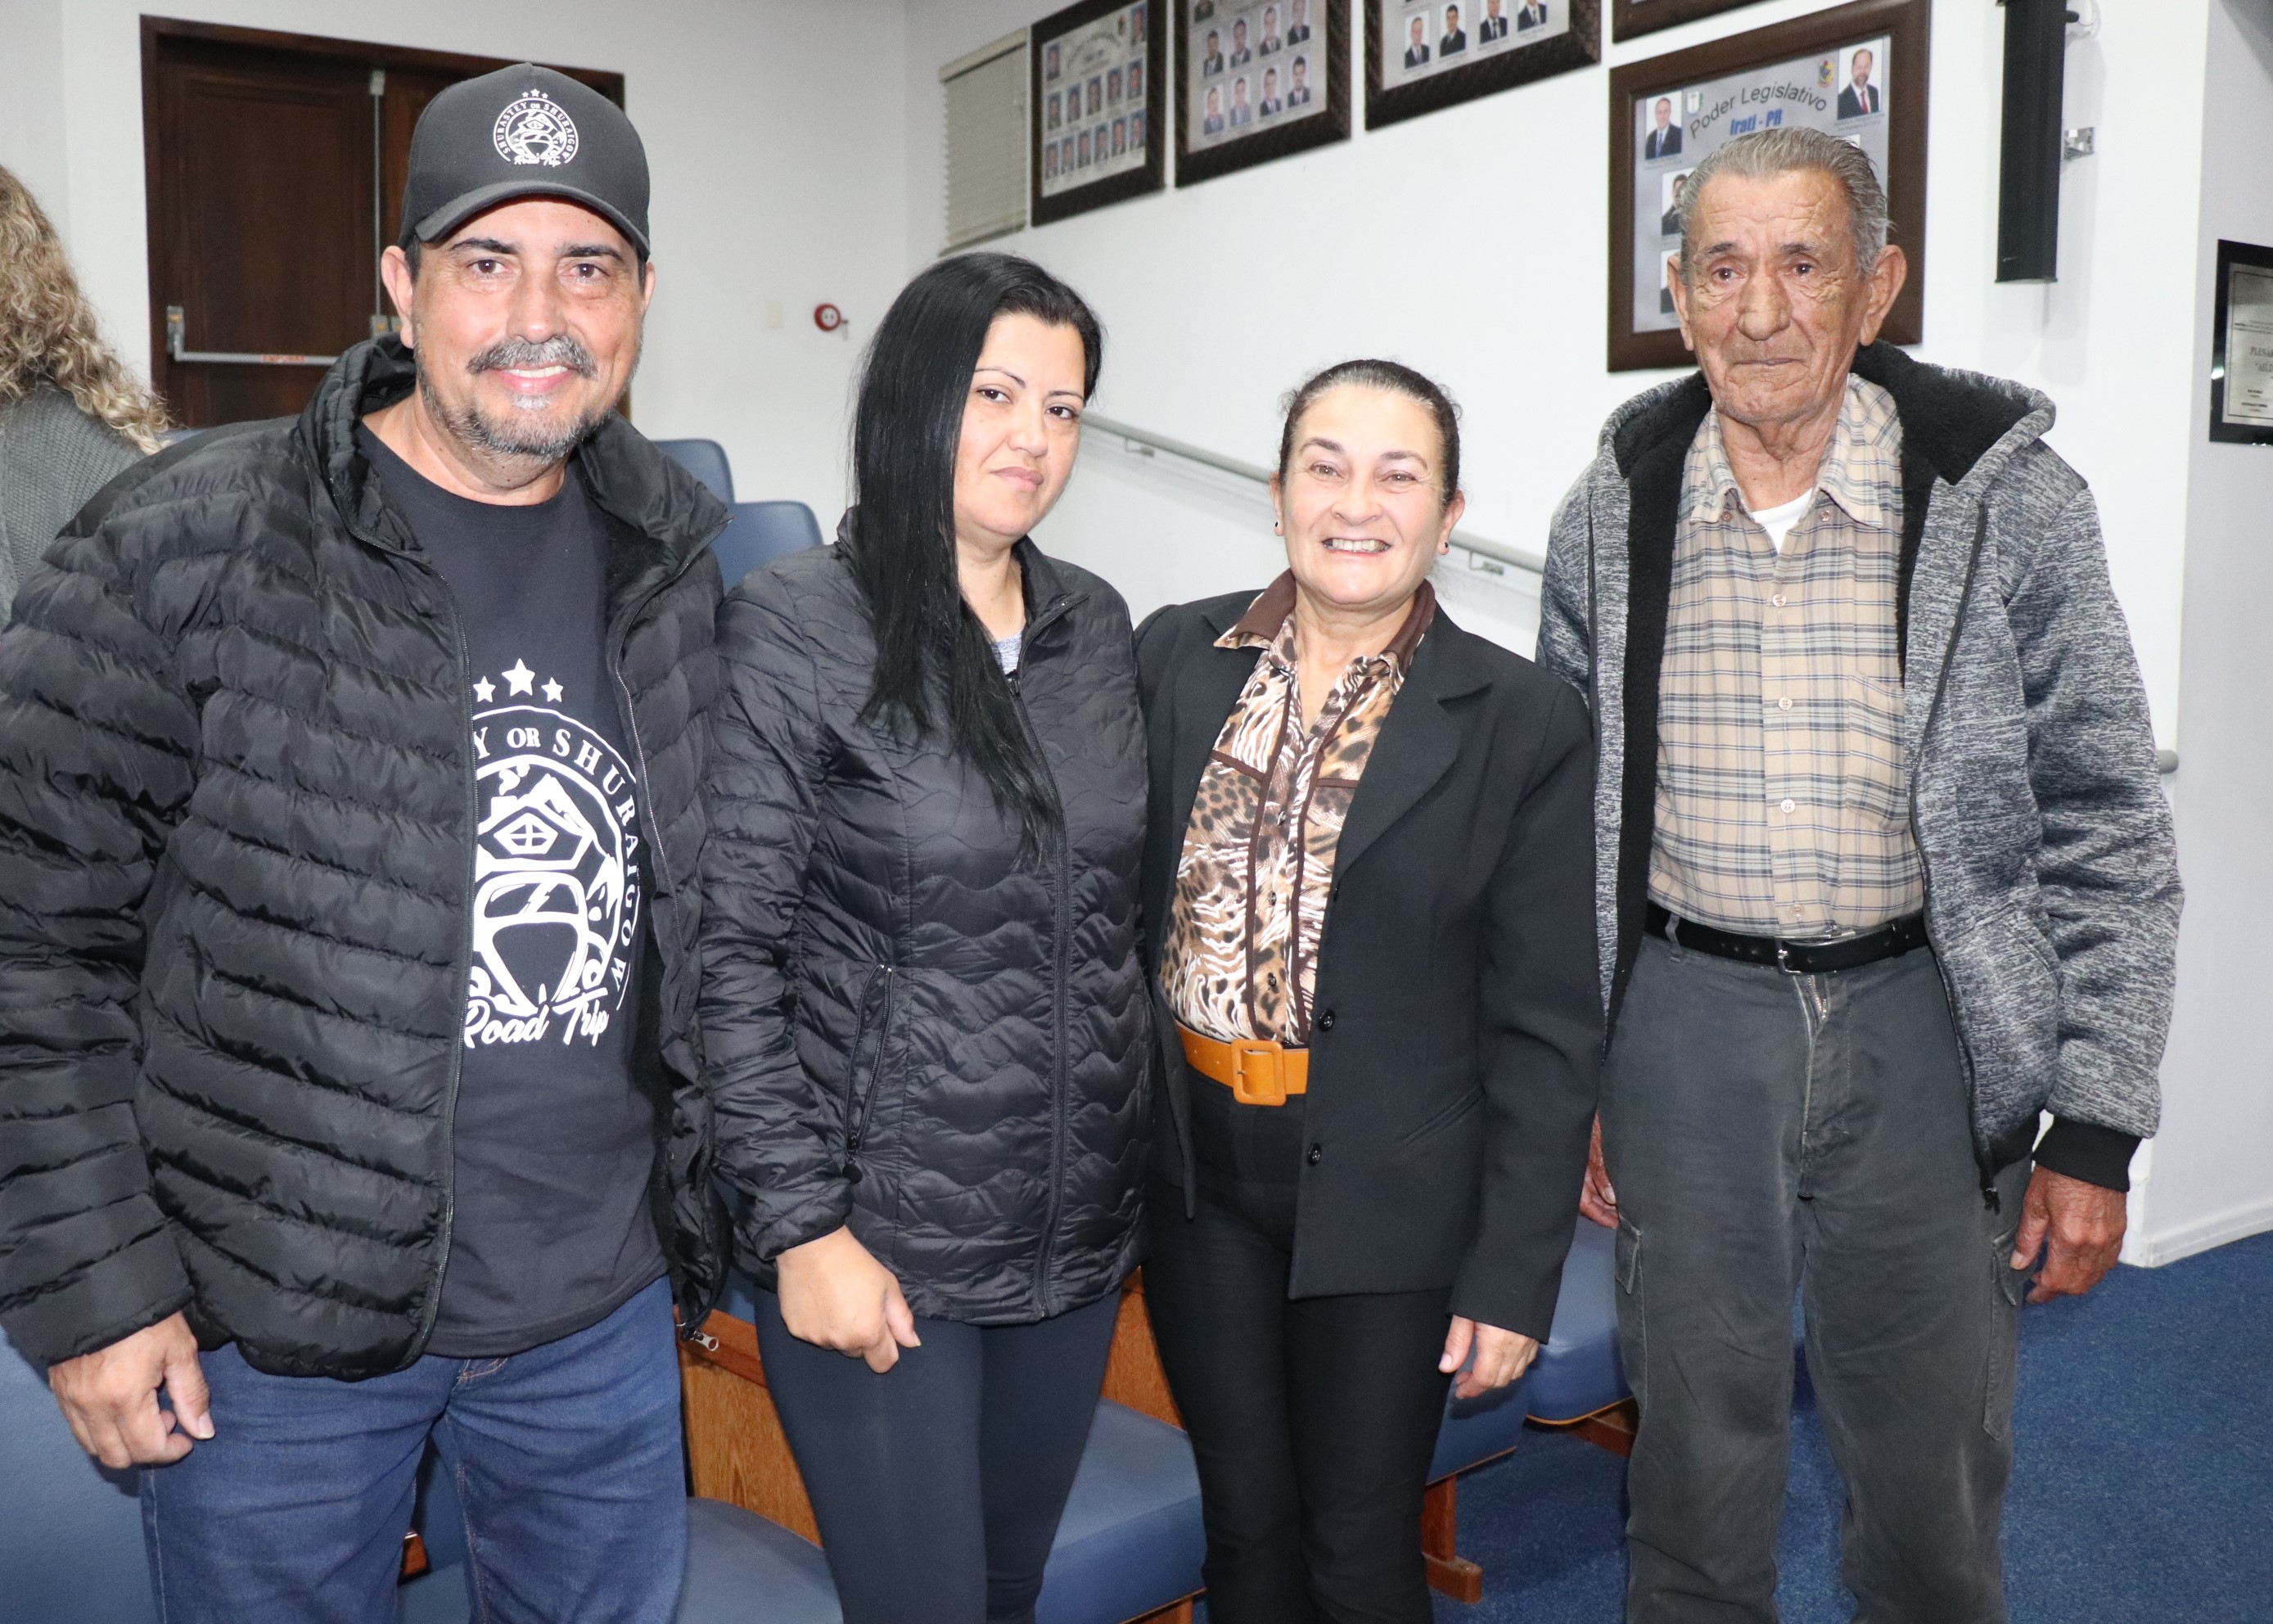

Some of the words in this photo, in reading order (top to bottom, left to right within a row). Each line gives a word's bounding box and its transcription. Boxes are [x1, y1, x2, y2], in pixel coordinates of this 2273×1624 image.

[497, 102, 527, 155] SHURASTEY
[543, 103, 575, 160] SHURAIGOW
[1689, 96, 1736, 139] Poder
[1741, 82, 1827, 112] Legislativo
[1729, 114, 1757, 136] Irati
[1766, 108, 1784, 128] PR
[507, 727, 541, 748] OR
[464, 999, 549, 1049] Road
[552, 987, 610, 1047] Trip
